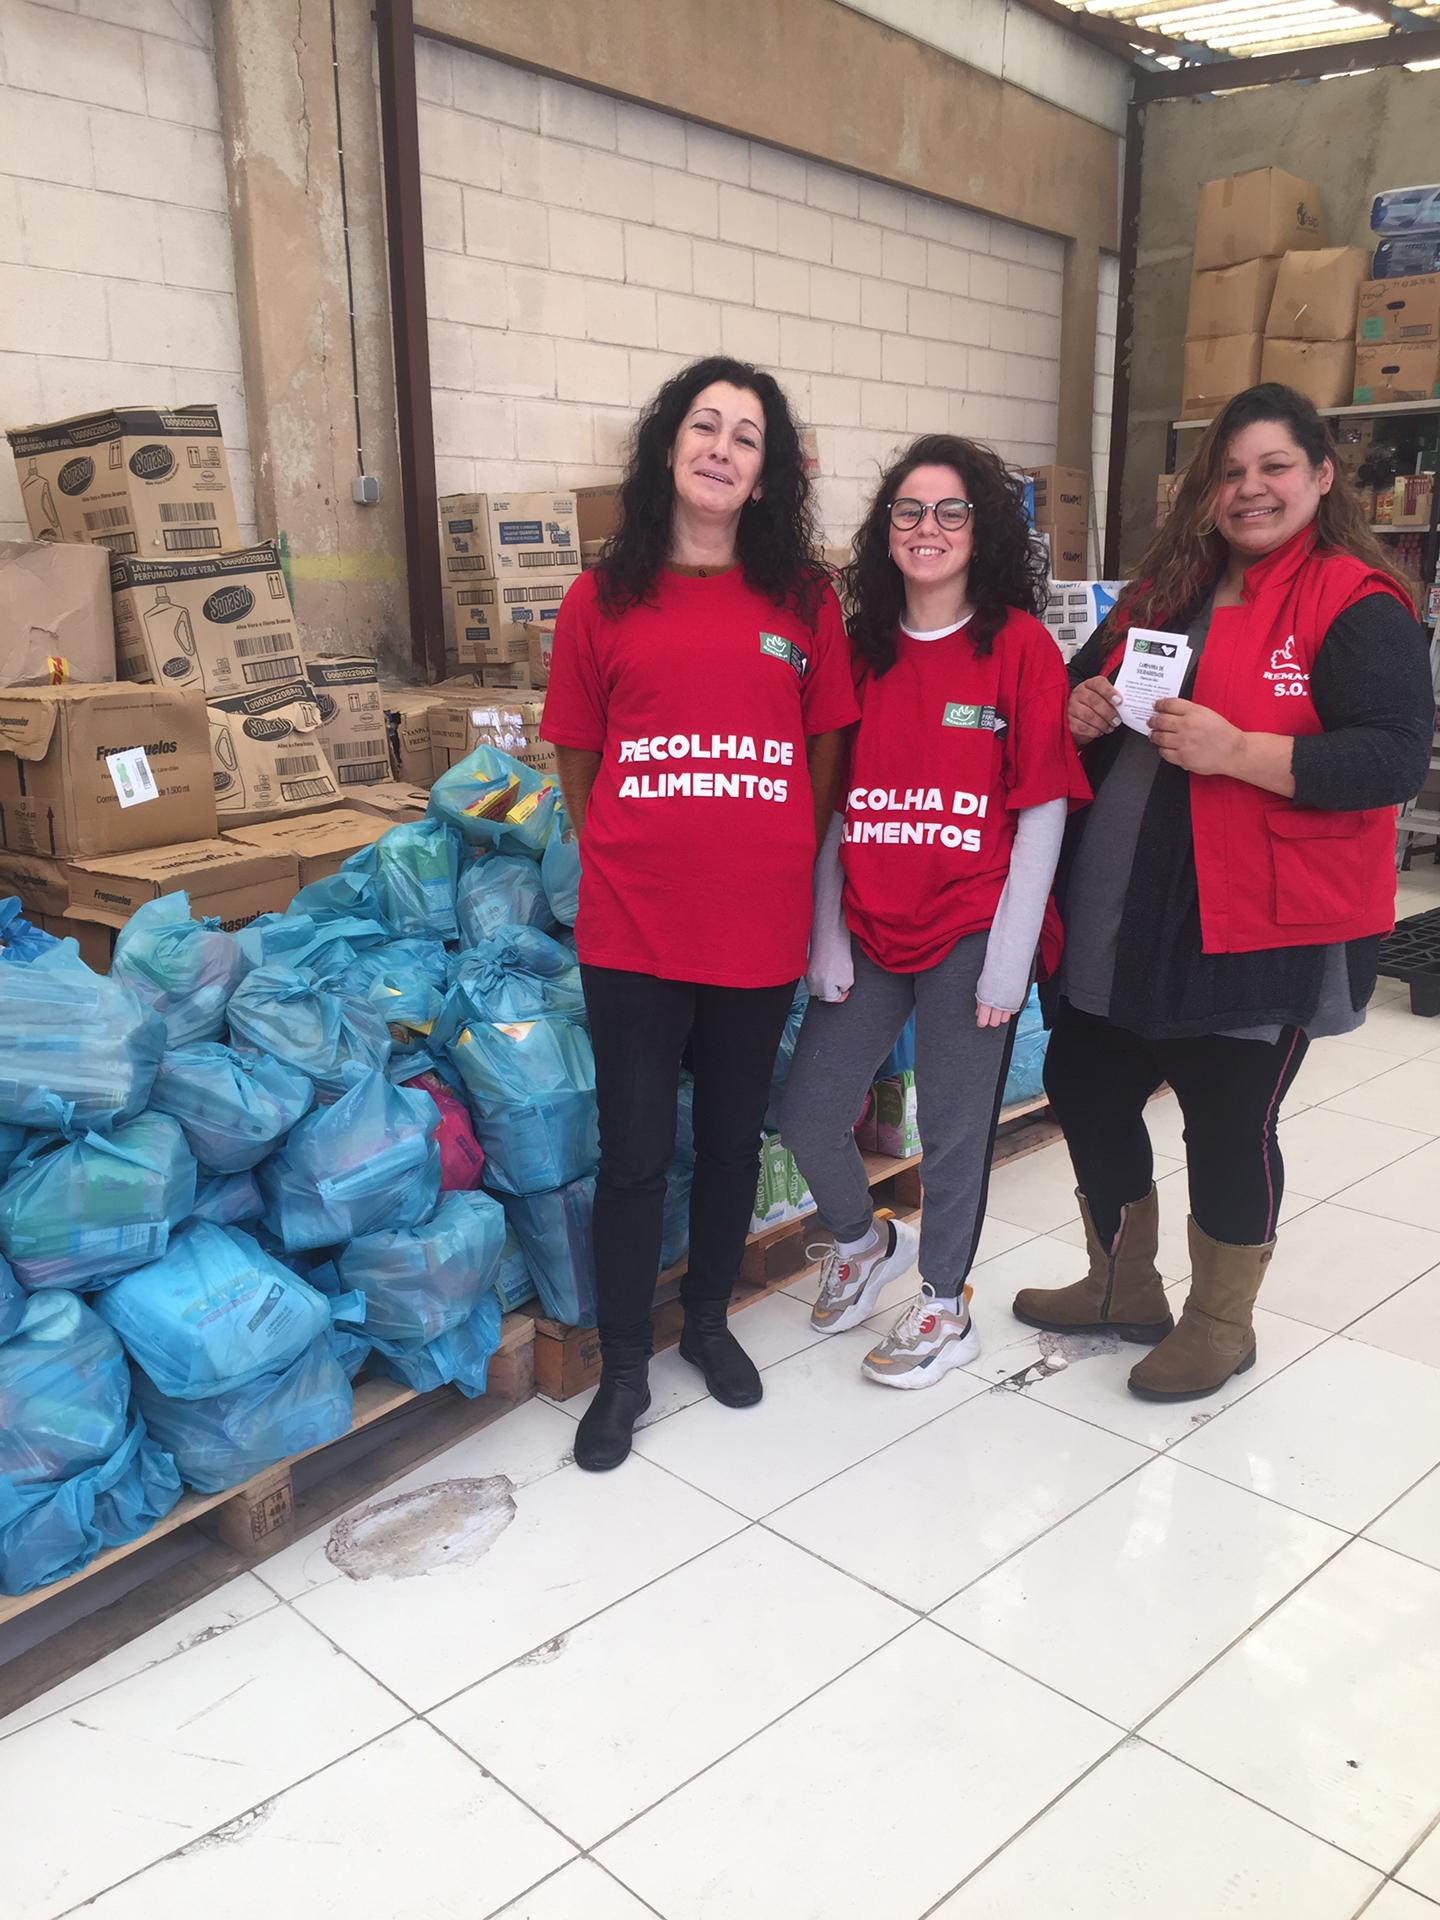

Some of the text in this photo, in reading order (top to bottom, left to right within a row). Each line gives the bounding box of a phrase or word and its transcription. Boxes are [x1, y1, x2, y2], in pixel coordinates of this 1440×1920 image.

[133, 569, 178, 582] PERFUMADO
[180, 566, 199, 577] ALOE
[199, 564, 217, 575] VERA
[208, 584, 251, 620] Sonasol
[618, 734, 794, 766] RECOLHA DE
[618, 773, 788, 802] ALIMENTOS
[845, 787, 944, 812] COLHA
[841, 821, 981, 852] LIMENTOS
